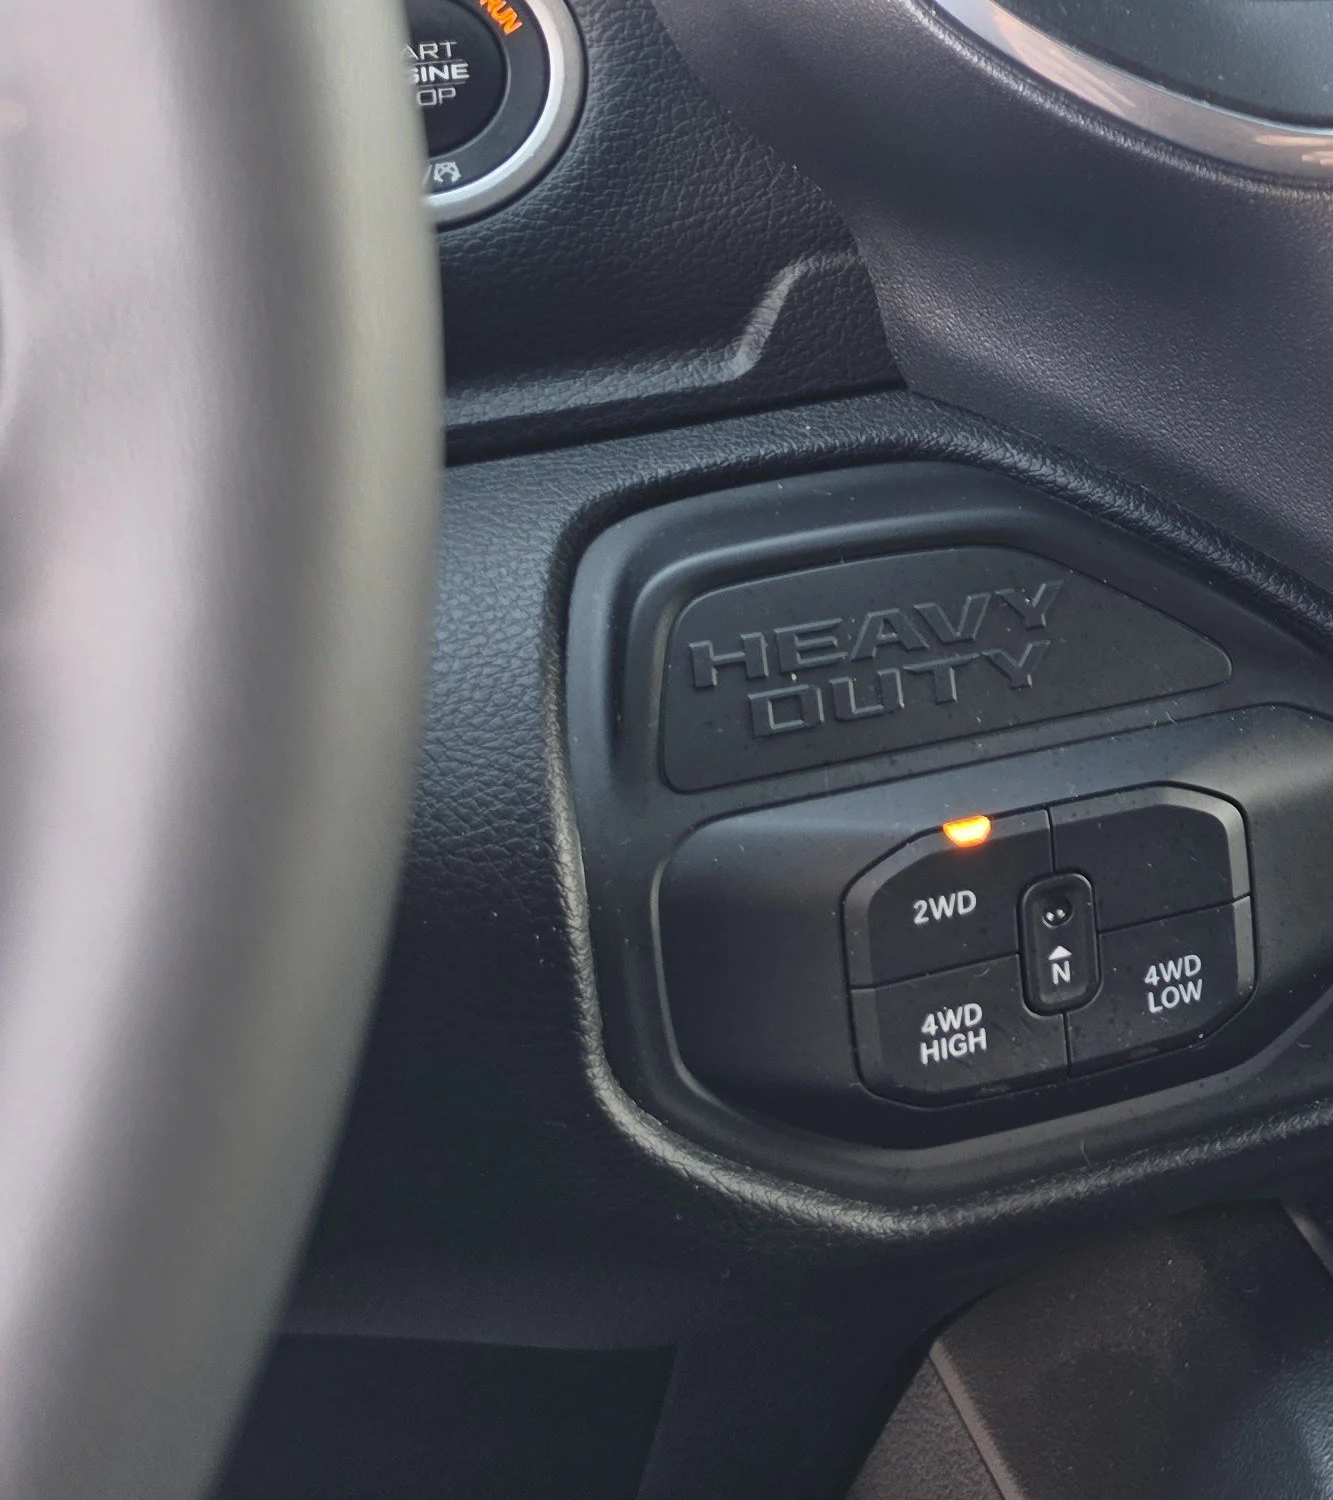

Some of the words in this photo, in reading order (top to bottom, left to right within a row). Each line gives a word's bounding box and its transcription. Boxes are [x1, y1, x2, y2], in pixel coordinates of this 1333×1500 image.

[688, 580, 1066, 690] HEAVY
[746, 638, 1052, 739] DUTY
[912, 890, 978, 924] 2WD
[1051, 959, 1072, 984] N
[1144, 953, 1203, 988] 4WD
[1145, 978, 1205, 1014] LOW
[920, 1003, 983, 1039] 4WD
[919, 1027, 989, 1065] HIGH
